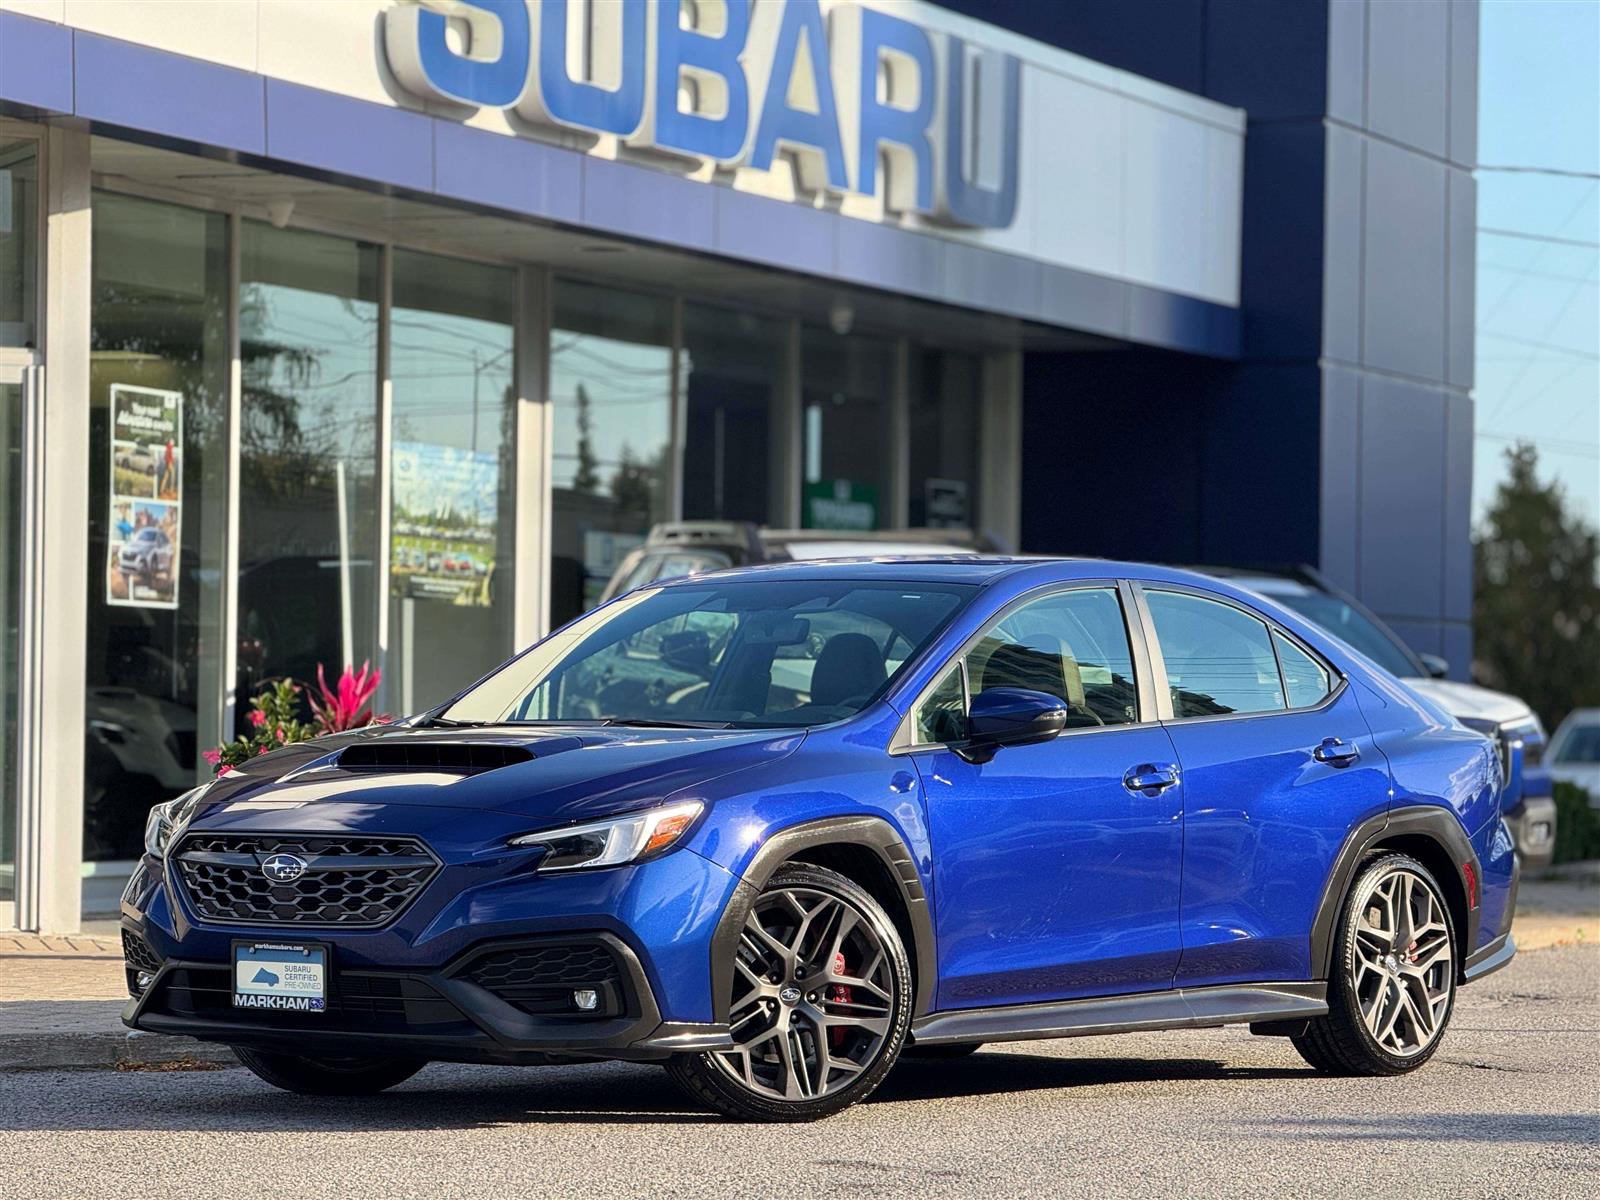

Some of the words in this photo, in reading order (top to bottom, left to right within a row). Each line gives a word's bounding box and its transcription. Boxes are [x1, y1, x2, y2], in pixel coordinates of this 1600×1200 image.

[284, 965, 311, 973] SUBARU
[284, 974, 318, 982] CERTIFIED
[284, 982, 321, 990] PRE-OWNED
[234, 994, 309, 1010] MARKHAM
